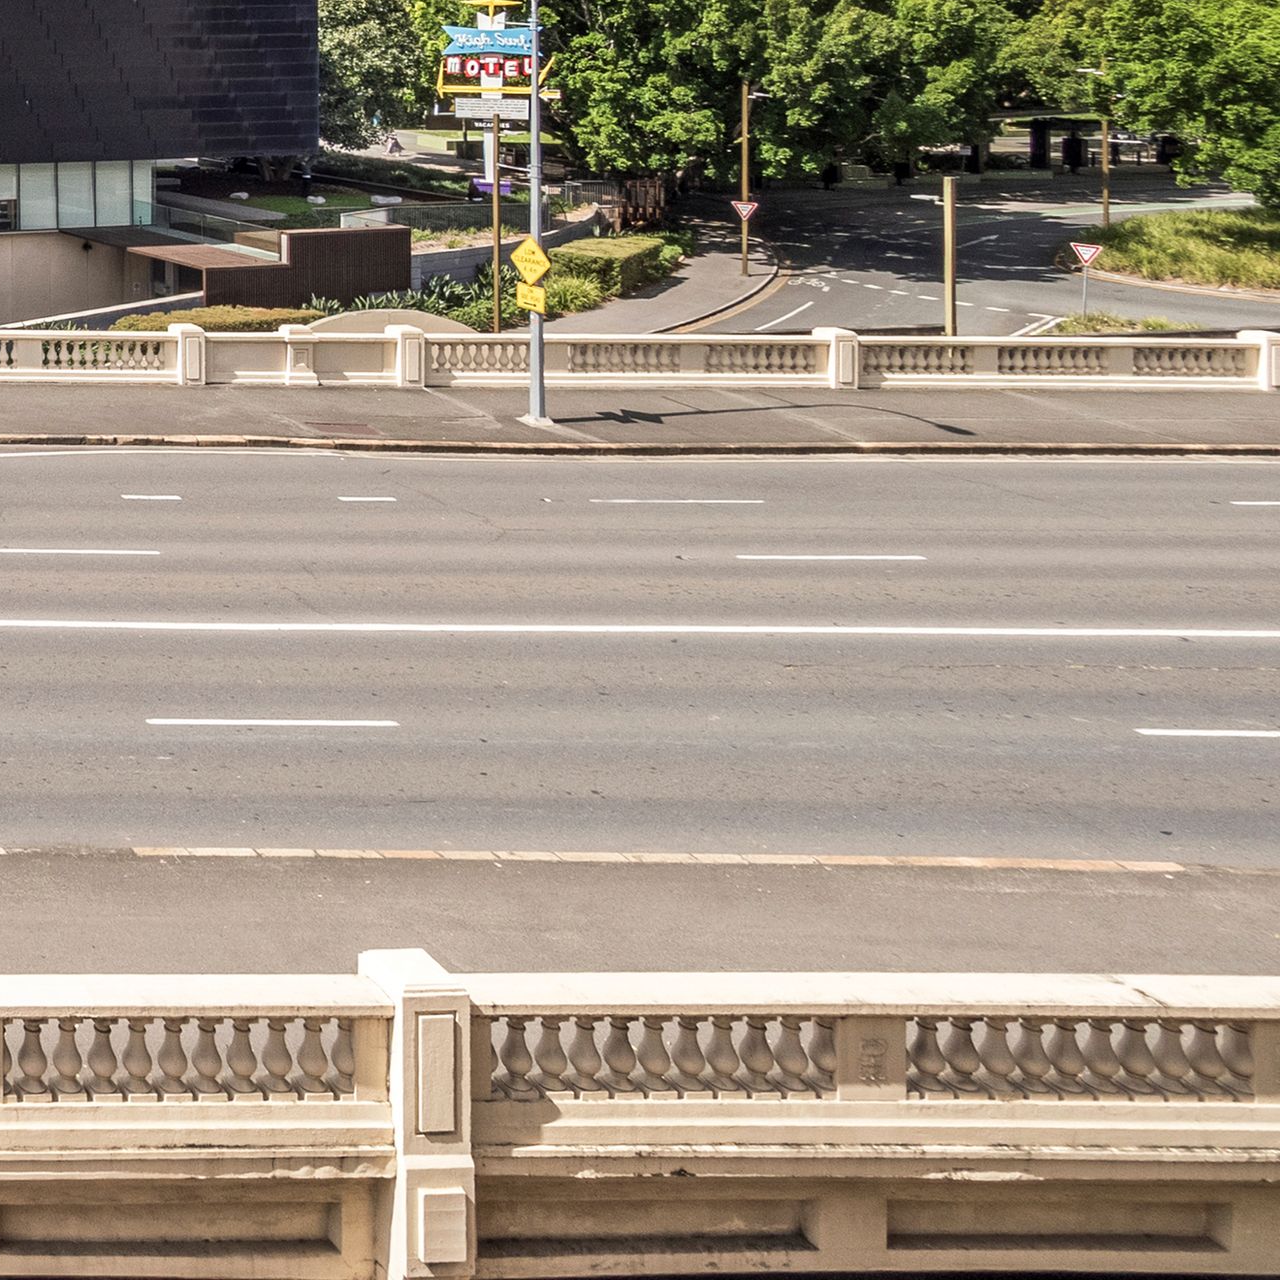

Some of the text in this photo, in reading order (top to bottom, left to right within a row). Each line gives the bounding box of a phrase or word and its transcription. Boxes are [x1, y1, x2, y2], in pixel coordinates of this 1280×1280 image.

[455, 33, 531, 50] High Surf
[446, 57, 532, 77] MOTEL
